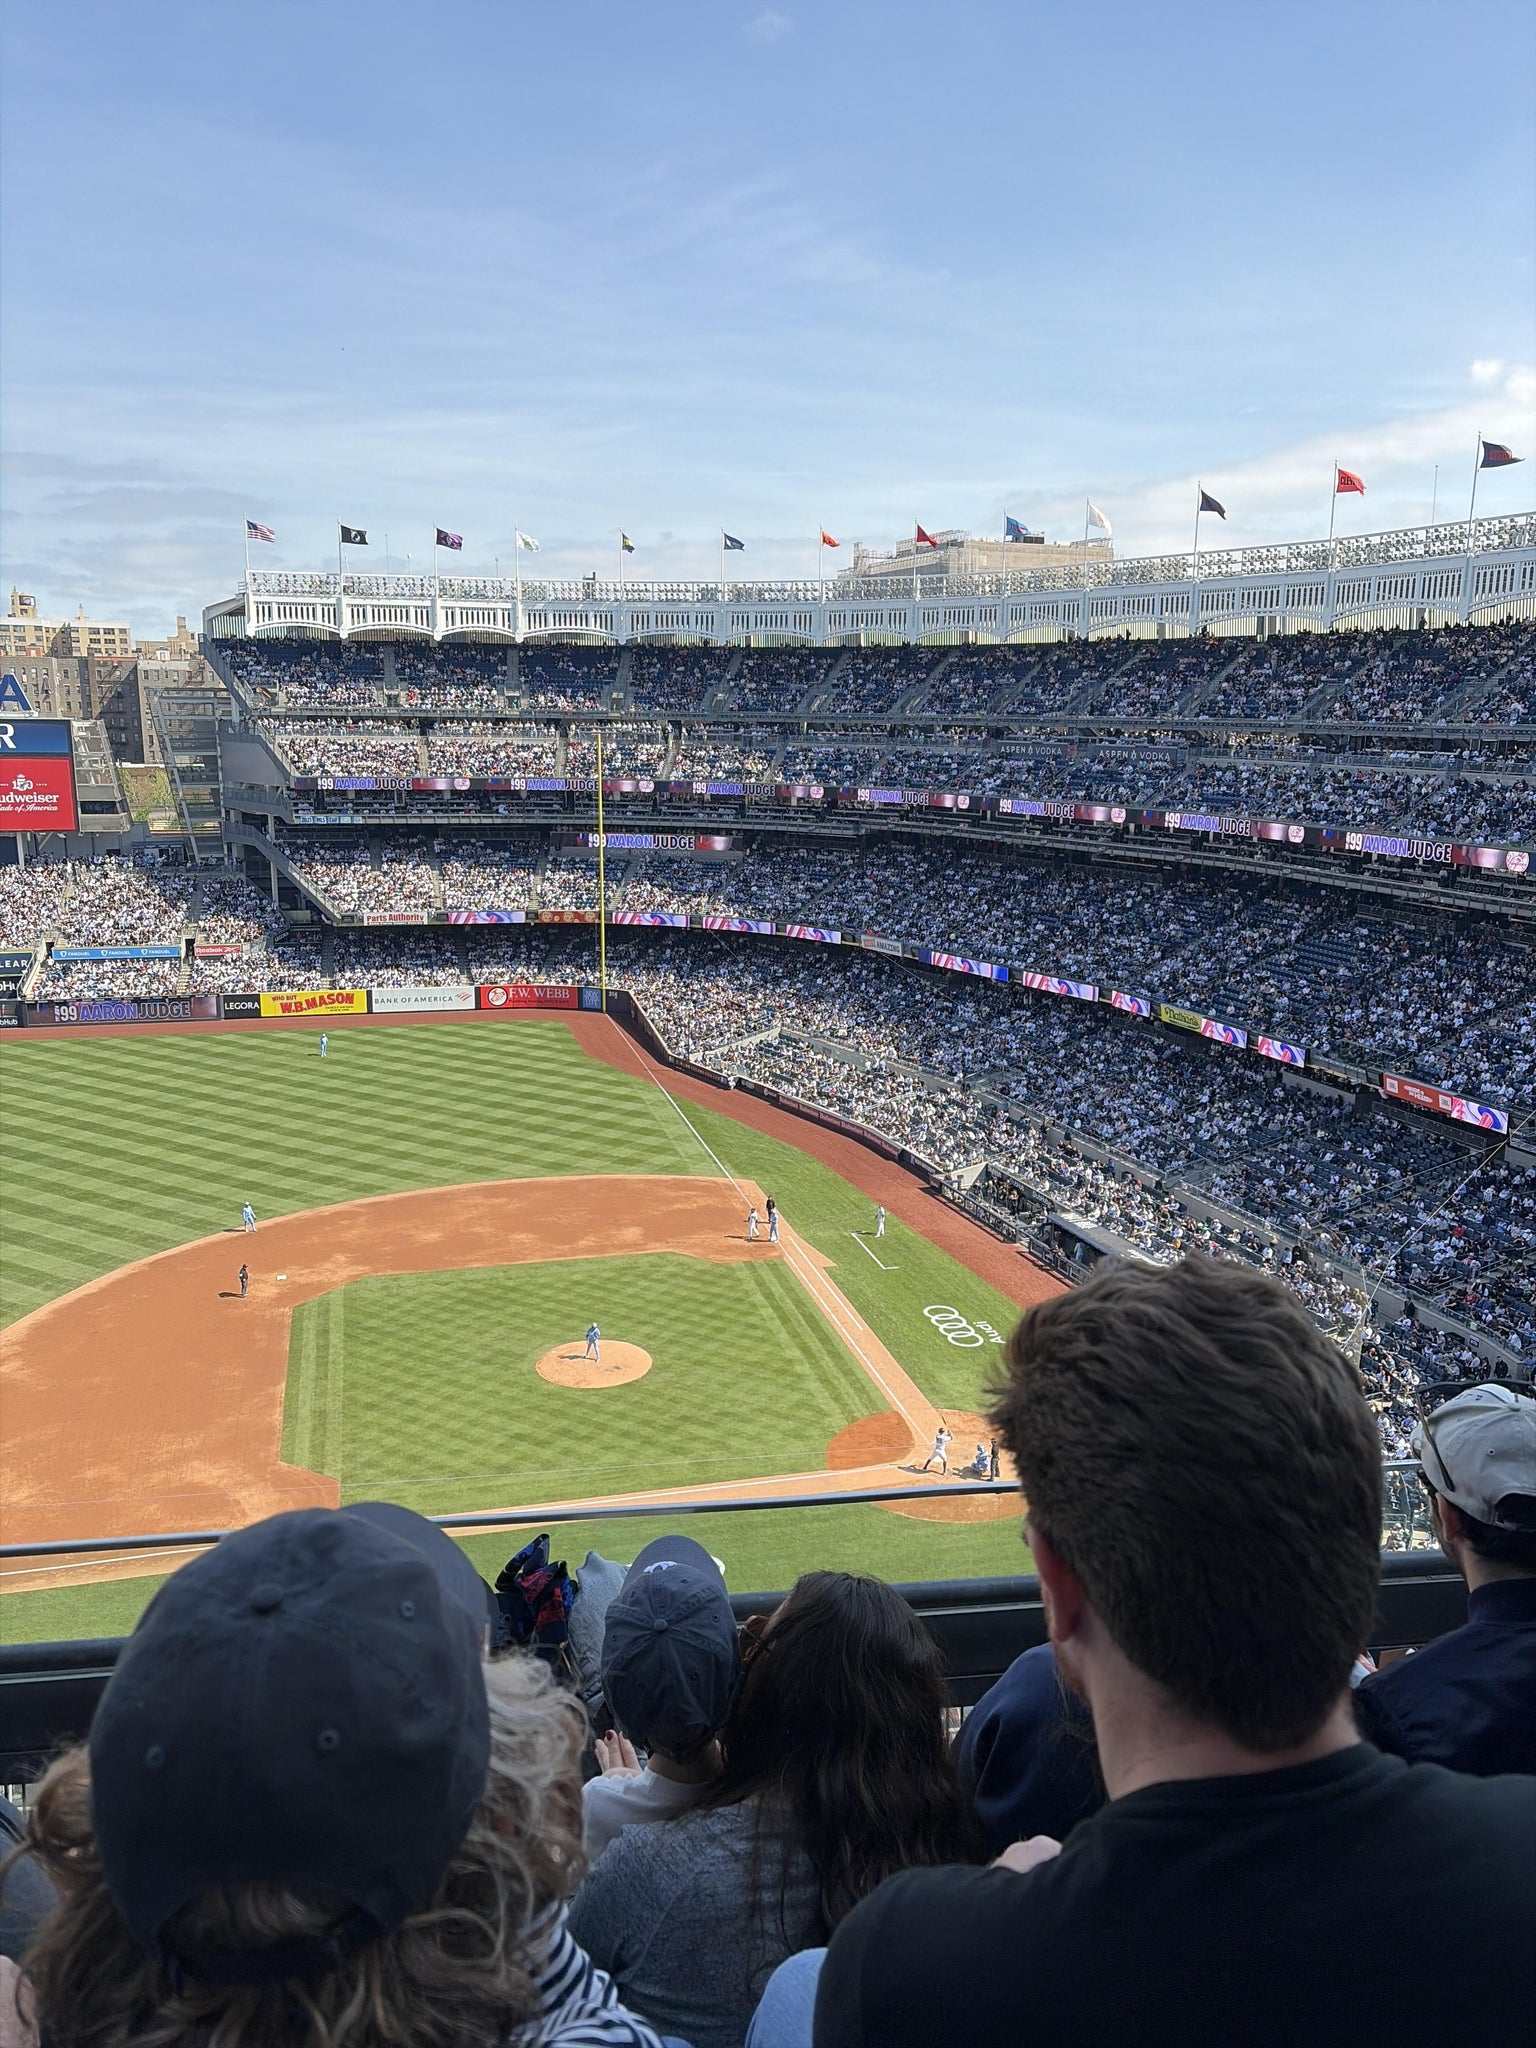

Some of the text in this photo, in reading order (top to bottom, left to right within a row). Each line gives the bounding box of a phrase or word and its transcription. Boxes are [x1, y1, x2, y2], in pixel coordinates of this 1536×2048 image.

[0, 674, 33, 711] A
[1000, 745, 1062, 755] ASPEN VODKA
[1099, 750, 1171, 761] ASPEN VODKA
[321, 777, 333, 789] 99
[334, 777, 375, 790] AARON
[375, 778, 412, 790] JUDGE
[514, 779, 526, 790] 99
[527, 779, 565, 791] AARON
[696, 782, 775, 796] 99 AARON JUDGE
[860, 788, 929, 805] 99 AARON JUDGE
[23, 803, 58, 812] America
[1001, 799, 1075, 819] 99 AARON JUDGE
[1168, 812, 1250, 836] 99 AARON JUDGE
[607, 834, 653, 849] AARON
[654, 835, 695, 850] JUDGE
[1350, 833, 1452, 862] 99 AARON JUDGE
[389, 913, 424, 921] Authority
[413, 995, 453, 1003] AMERICA
[509, 988, 570, 998] F.W. WEBB
[60, 1004, 78, 1021] 99
[79, 1003, 137, 1021] AARON
[138, 1001, 191, 1018] JUDGE
[224, 1001, 260, 1010] LEGORA
[972, 1320, 1006, 1344] Audi
